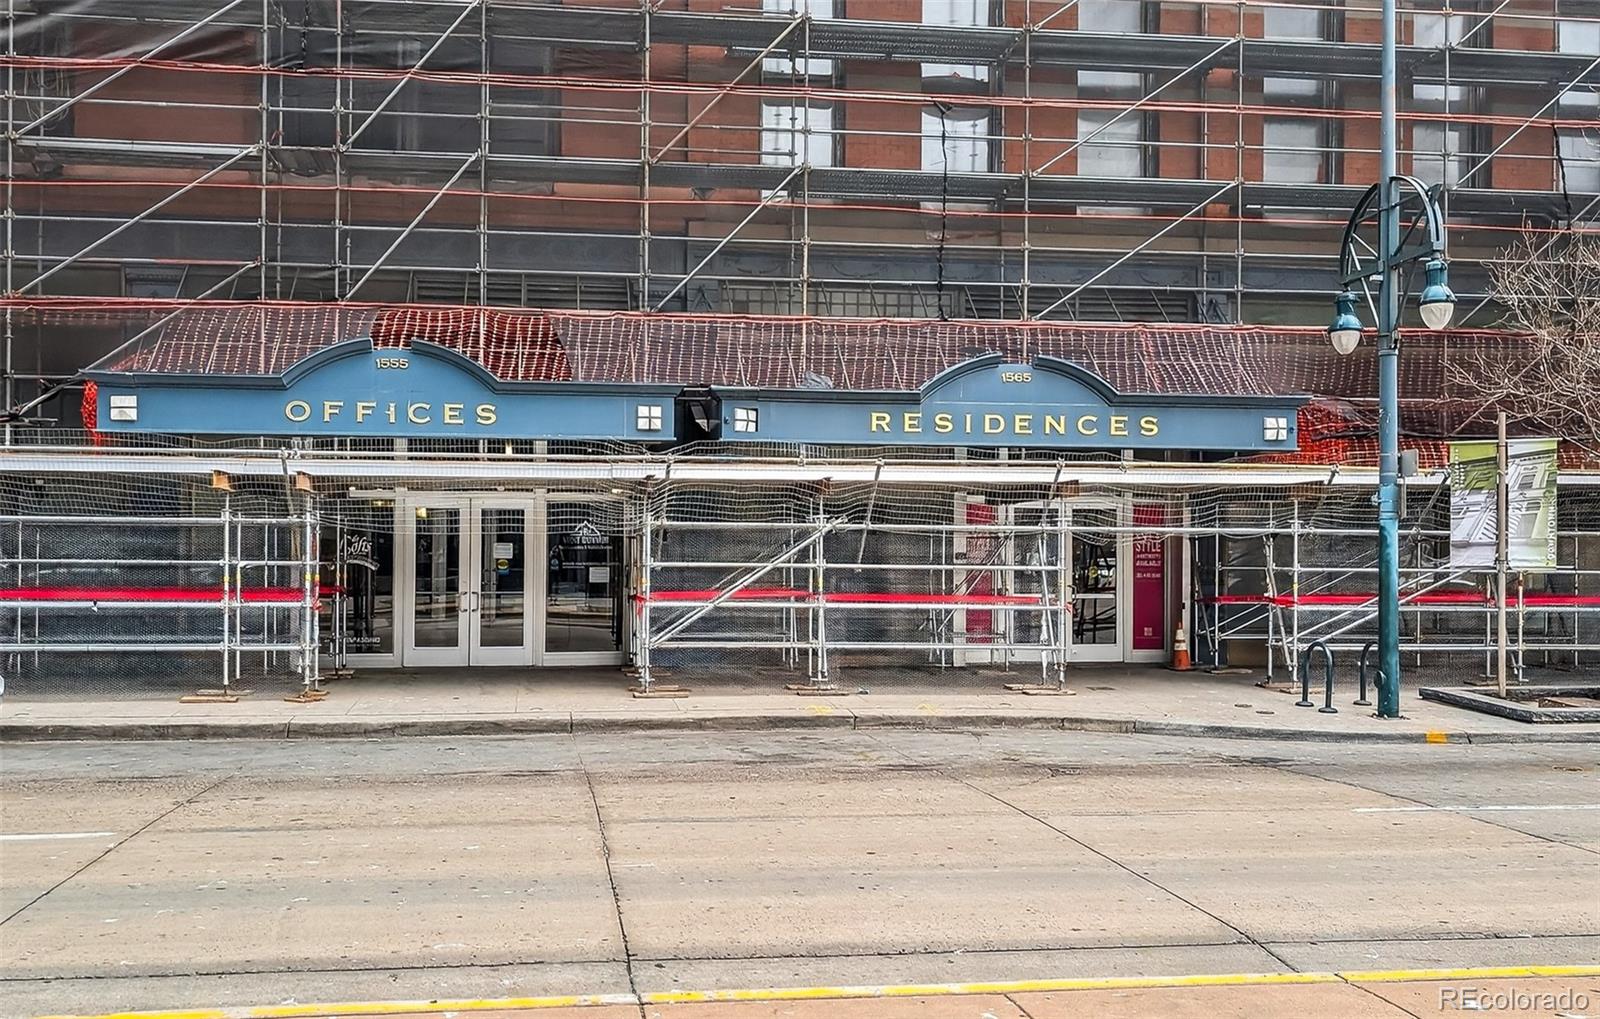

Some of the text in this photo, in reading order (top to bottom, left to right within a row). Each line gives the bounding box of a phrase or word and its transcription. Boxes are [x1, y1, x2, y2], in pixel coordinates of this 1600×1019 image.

[376, 358, 409, 369] 1555
[1001, 372, 1032, 383] 1565
[285, 400, 497, 425] OFFICES
[870, 412, 1160, 436] RESIDENCES
[1135, 541, 1161, 553] STYLE
